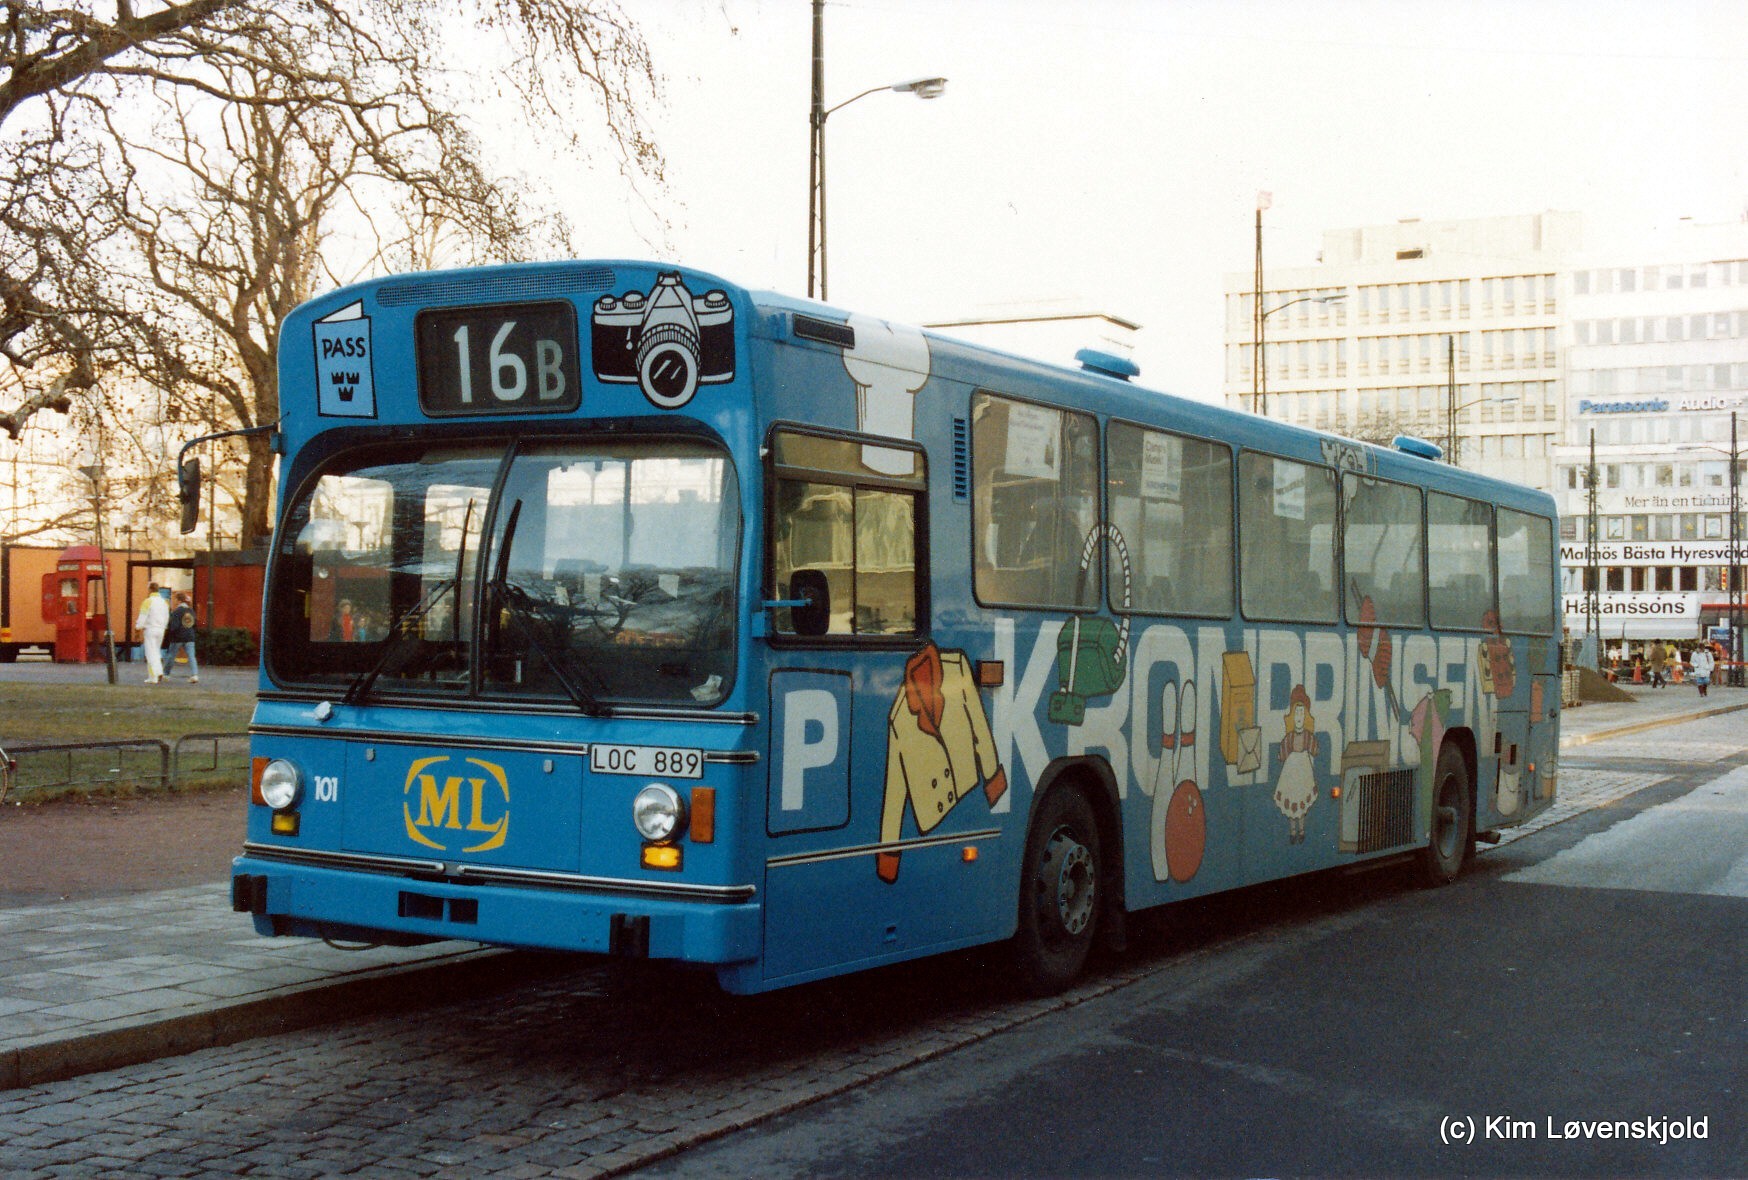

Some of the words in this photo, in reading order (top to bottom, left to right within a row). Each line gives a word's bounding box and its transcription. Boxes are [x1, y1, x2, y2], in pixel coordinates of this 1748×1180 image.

[323, 336, 366, 359] PASS
[1579, 397, 1670, 414] Panasonic
[1680, 396, 1728, 411] Audio
[1625, 496, 1647, 508] Mer
[1653, 496, 1668, 507] än
[1672, 496, 1688, 507] en
[1560, 547, 1617, 560] Malmös
[1623, 546, 1665, 560] Bästa
[594, 748, 636, 771] LOC
[654, 750, 699, 775] 889
[781, 690, 838, 811] P
[314, 776, 338, 802] 101
[415, 774, 503, 832] ML
